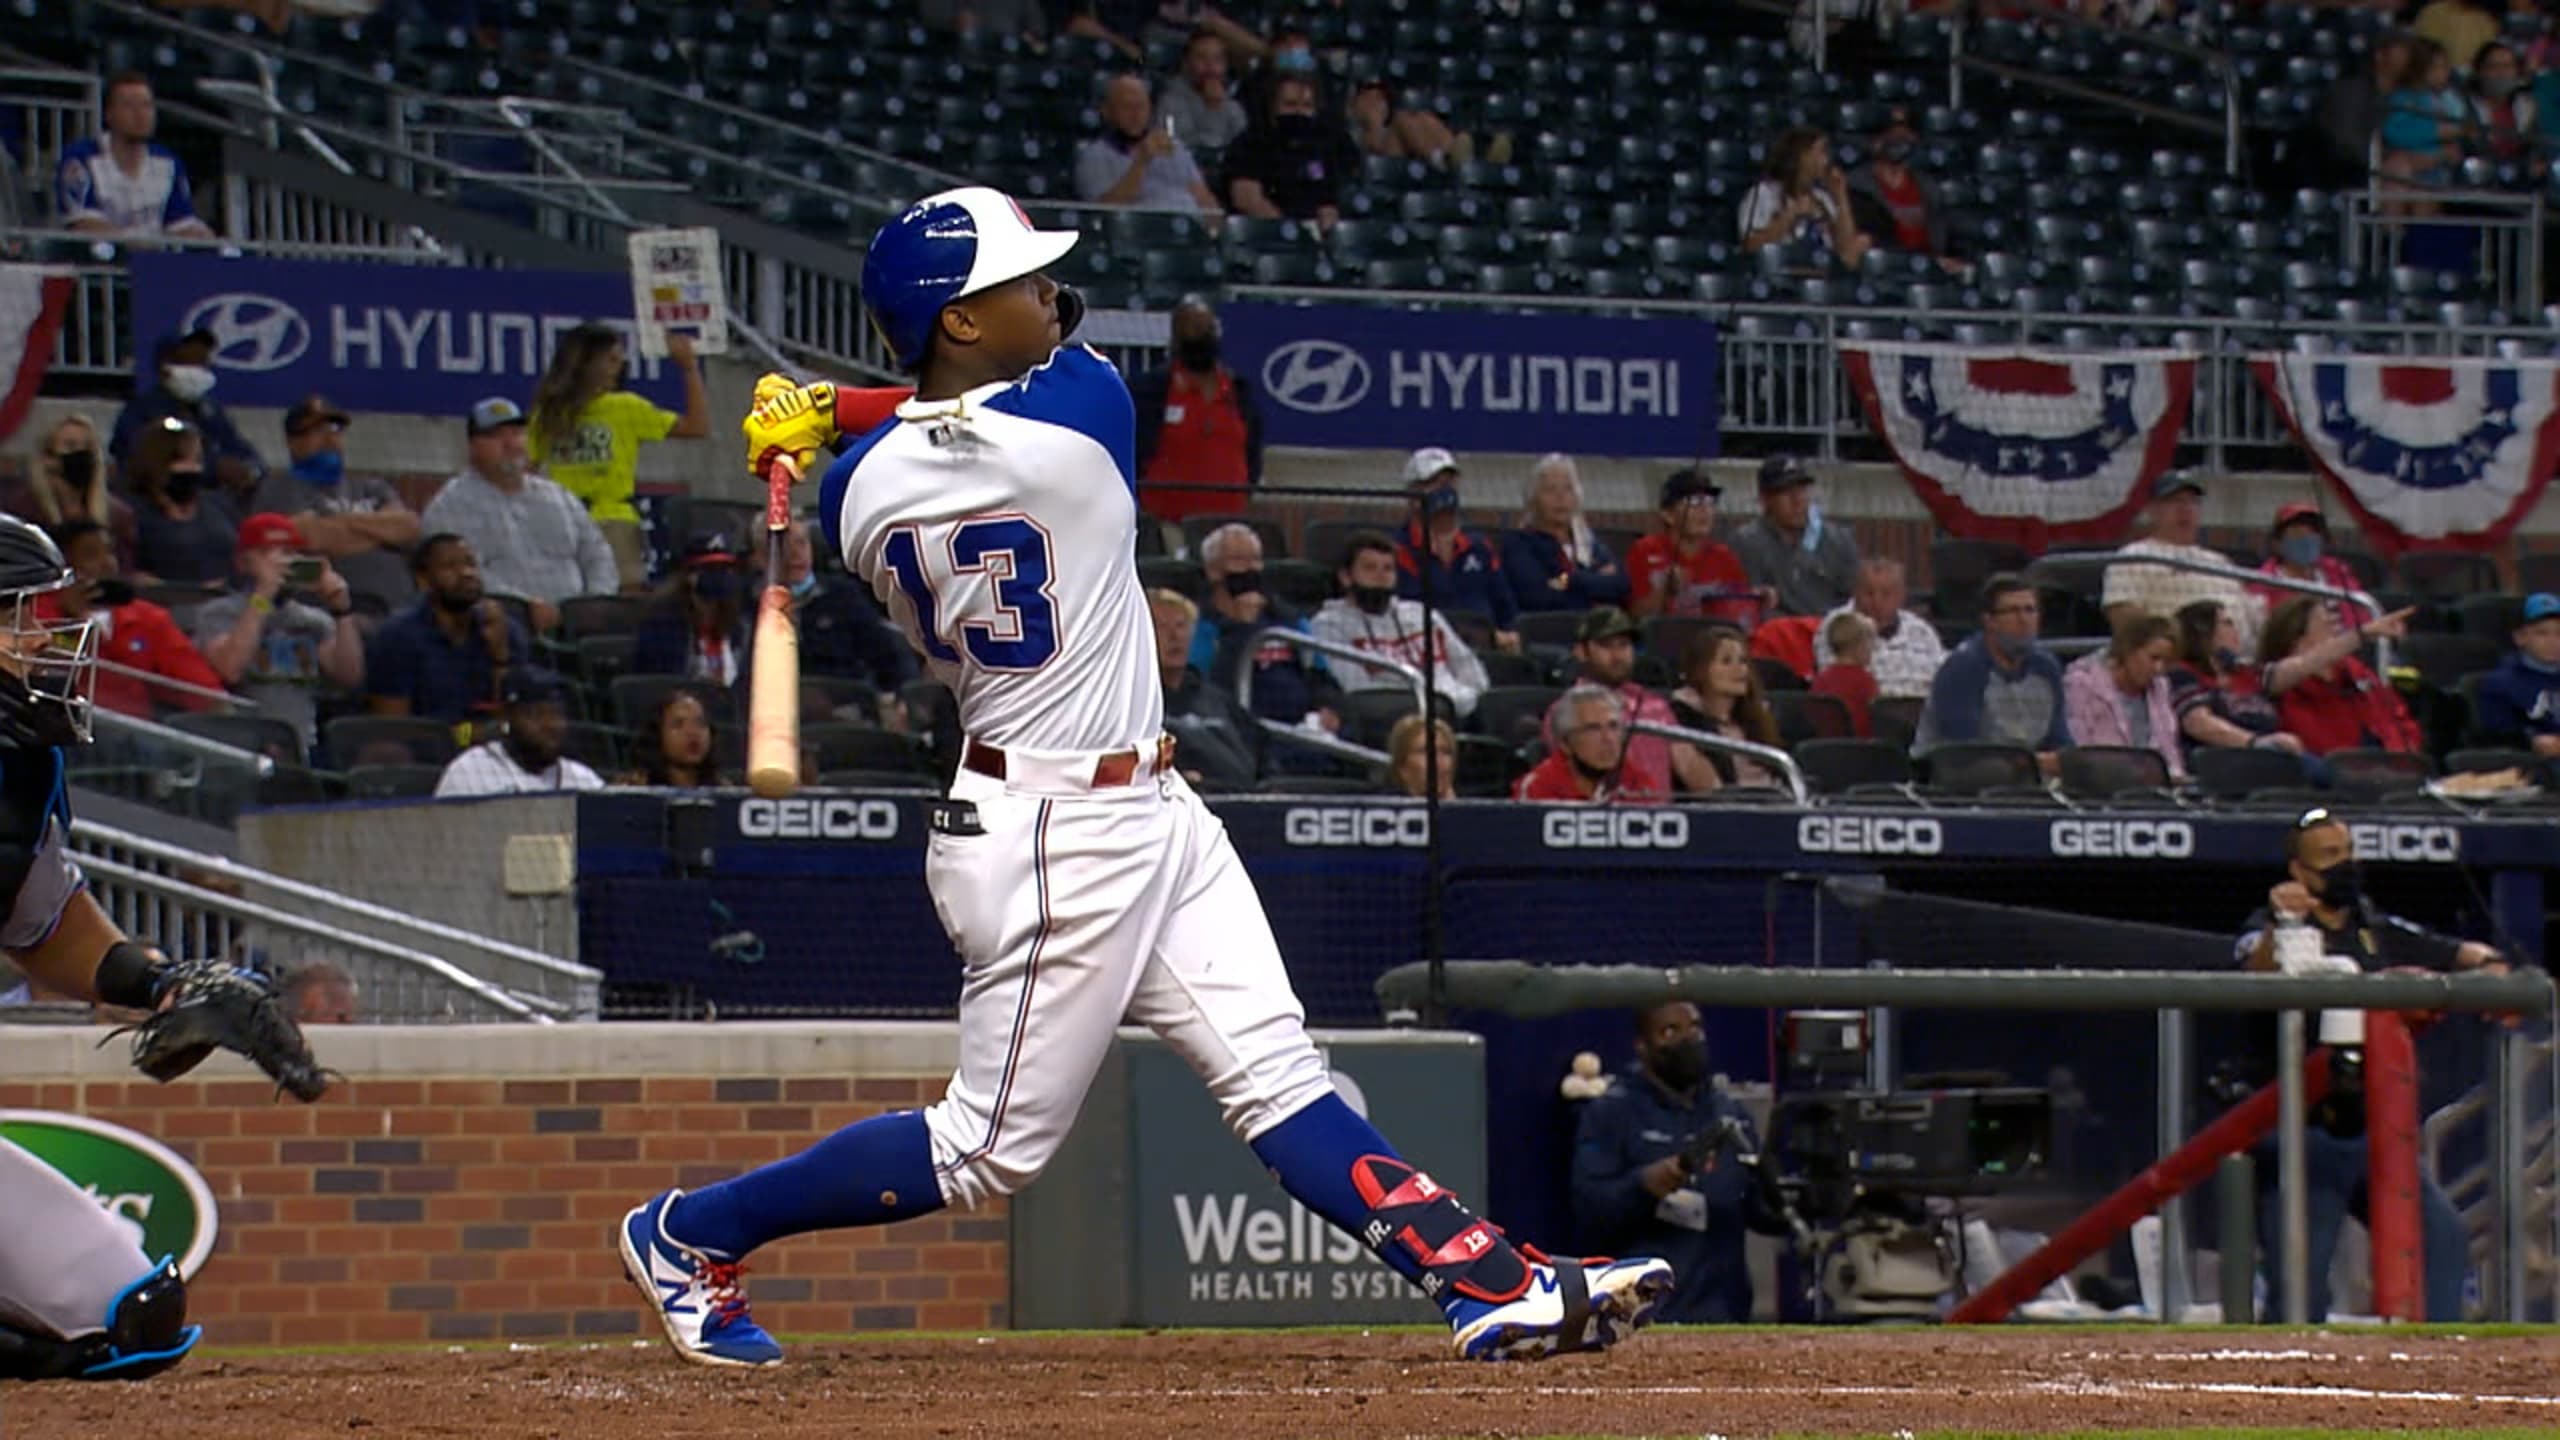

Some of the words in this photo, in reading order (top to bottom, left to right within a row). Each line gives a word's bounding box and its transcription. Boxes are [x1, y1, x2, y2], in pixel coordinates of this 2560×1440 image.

[1389, 350, 1680, 417] HYUNDAI
[880, 512, 1064, 674] 13
[738, 799, 898, 838] GEICO
[1284, 808, 1430, 846] GEICO
[1543, 811, 1690, 848] GEICO
[1798, 816, 1943, 855] GEICO
[2050, 820, 2194, 858] GEICO
[2350, 823, 2459, 862] EICO
[1172, 1193, 1383, 1264] Wells
[1463, 1229, 1489, 1254] 13
[1190, 1271, 1313, 1300] HEALTH
